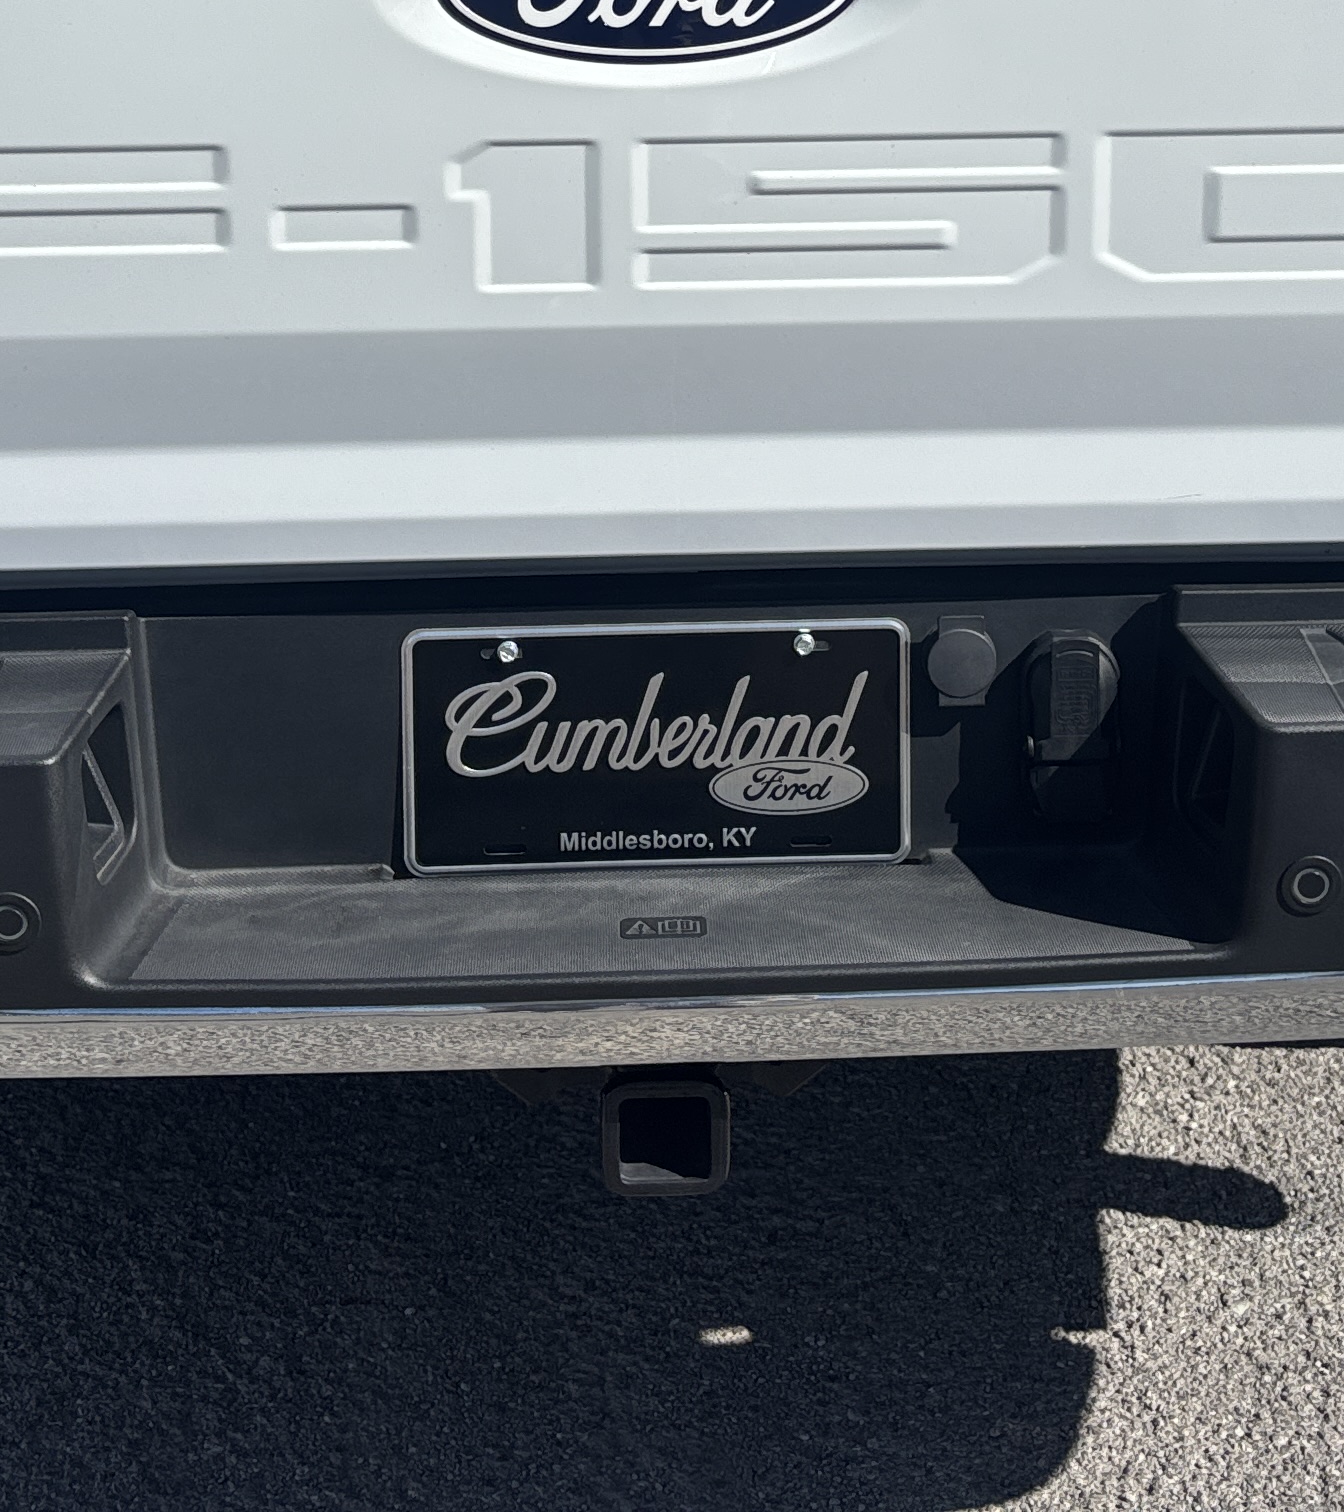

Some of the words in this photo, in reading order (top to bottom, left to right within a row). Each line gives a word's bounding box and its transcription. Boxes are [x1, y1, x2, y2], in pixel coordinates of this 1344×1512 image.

[444, 670, 869, 778] Cumberland
[742, 766, 835, 802] Ford
[559, 829, 714, 852] Middlesboro,
[721, 826, 757, 848] KY
